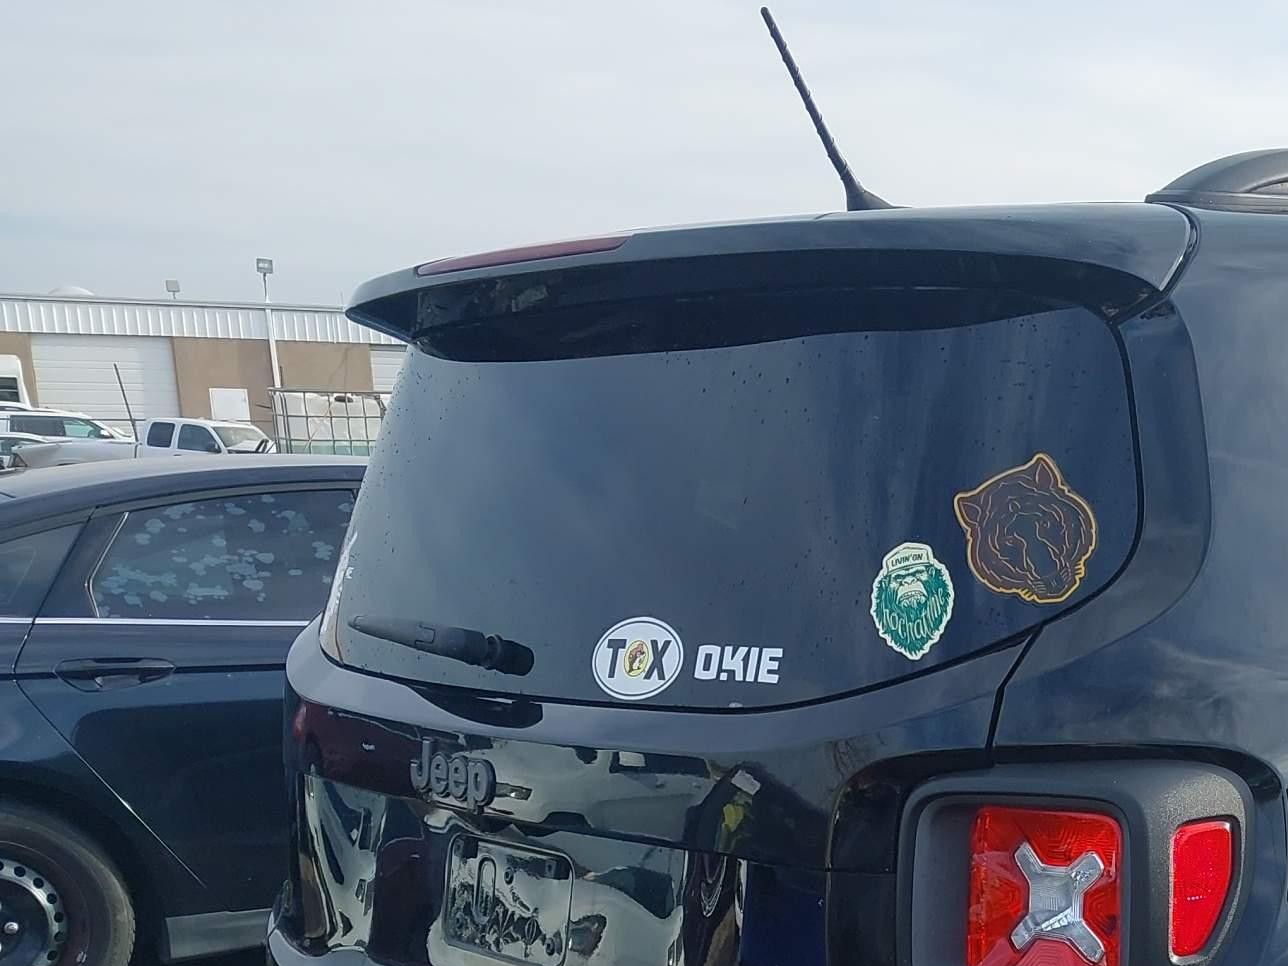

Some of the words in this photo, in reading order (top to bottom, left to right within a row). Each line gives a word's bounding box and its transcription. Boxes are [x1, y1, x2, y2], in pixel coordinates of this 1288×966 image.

[912, 553, 924, 562] ON
[693, 644, 784, 685] OKIE
[409, 736, 494, 812] Jeep
